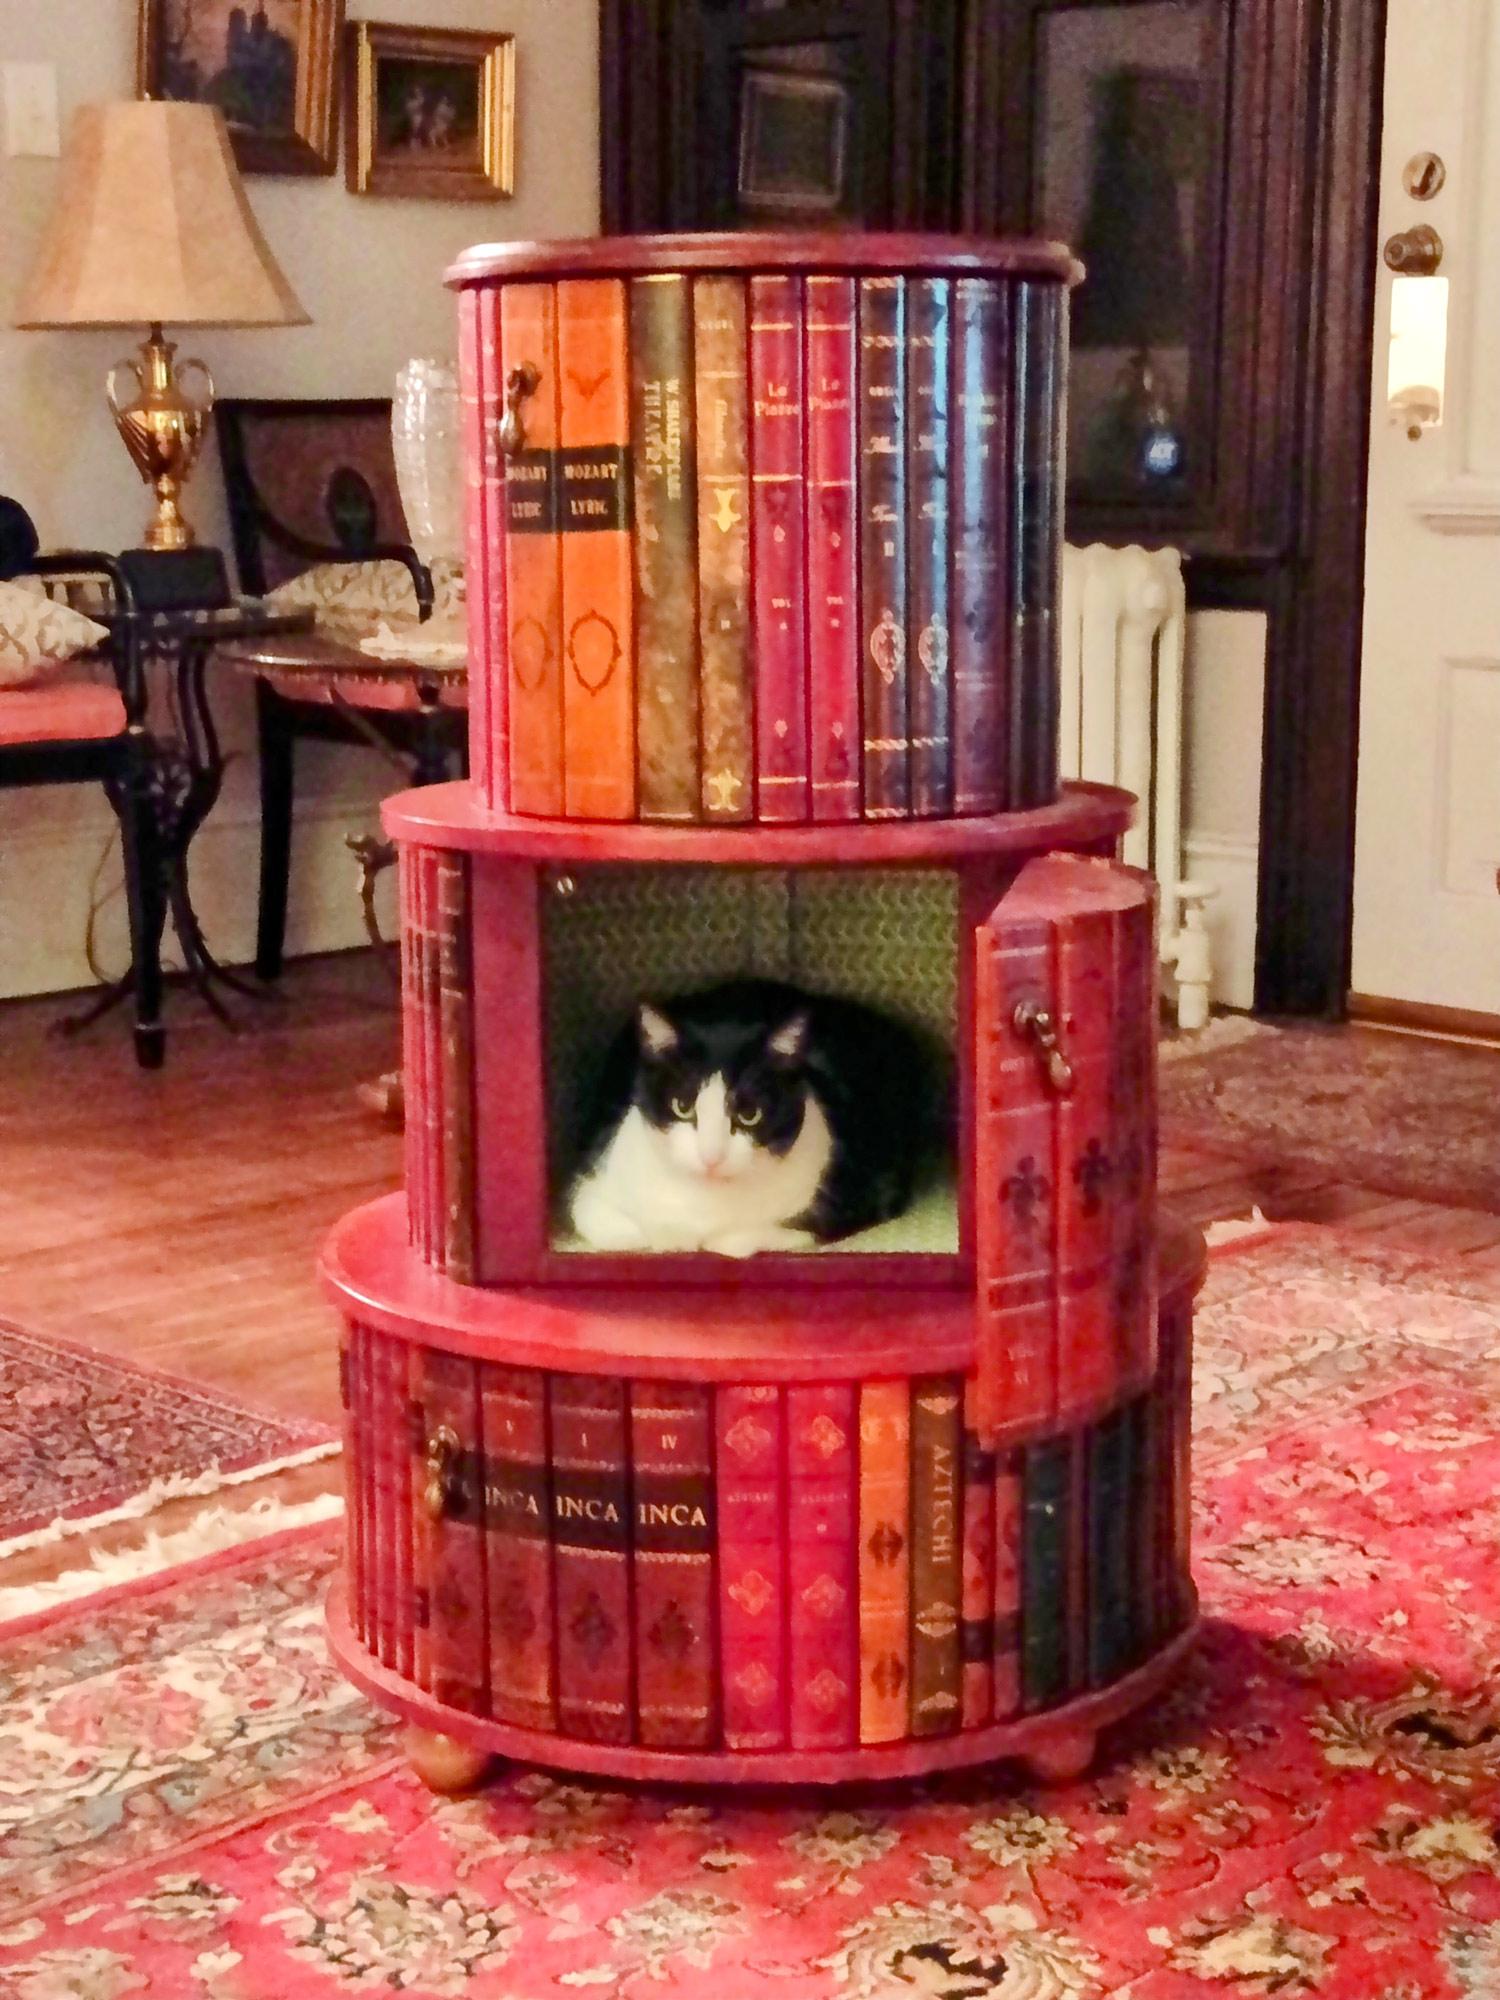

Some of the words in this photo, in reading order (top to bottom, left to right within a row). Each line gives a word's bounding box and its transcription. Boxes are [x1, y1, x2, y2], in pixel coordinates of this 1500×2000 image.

[564, 463, 618, 480] MOZART
[661, 1434, 678, 1449] IV
[555, 1494, 620, 1524] INCA
[638, 1503, 708, 1527] INCA
[931, 1443, 954, 1564] AZTECHI
